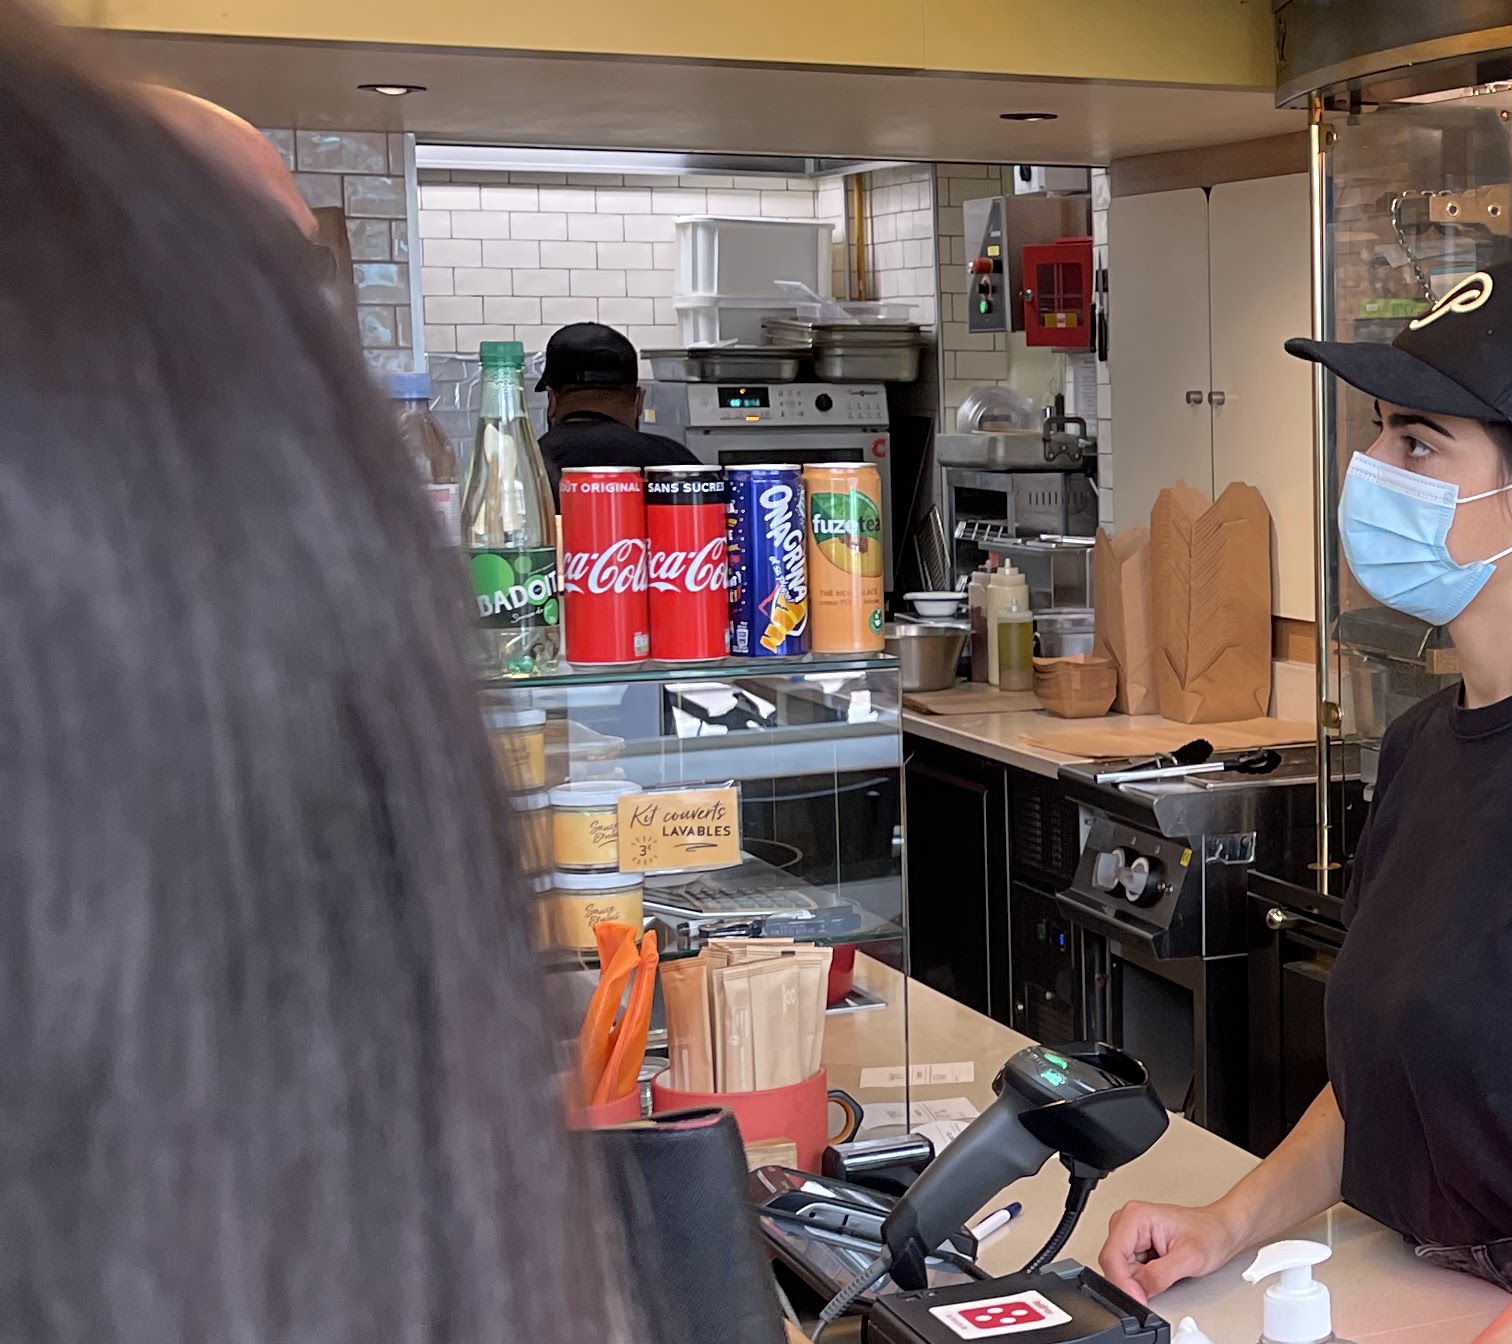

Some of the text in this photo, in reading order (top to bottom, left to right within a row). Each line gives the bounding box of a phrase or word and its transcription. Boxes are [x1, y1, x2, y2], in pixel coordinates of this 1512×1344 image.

[580, 482, 640, 493] ORIGINAL
[648, 482, 680, 494] SANS
[476, 570, 558, 616] BADOIT
[630, 801, 726, 828] Kit couverts
[662, 826, 731, 837] LAVABLES
